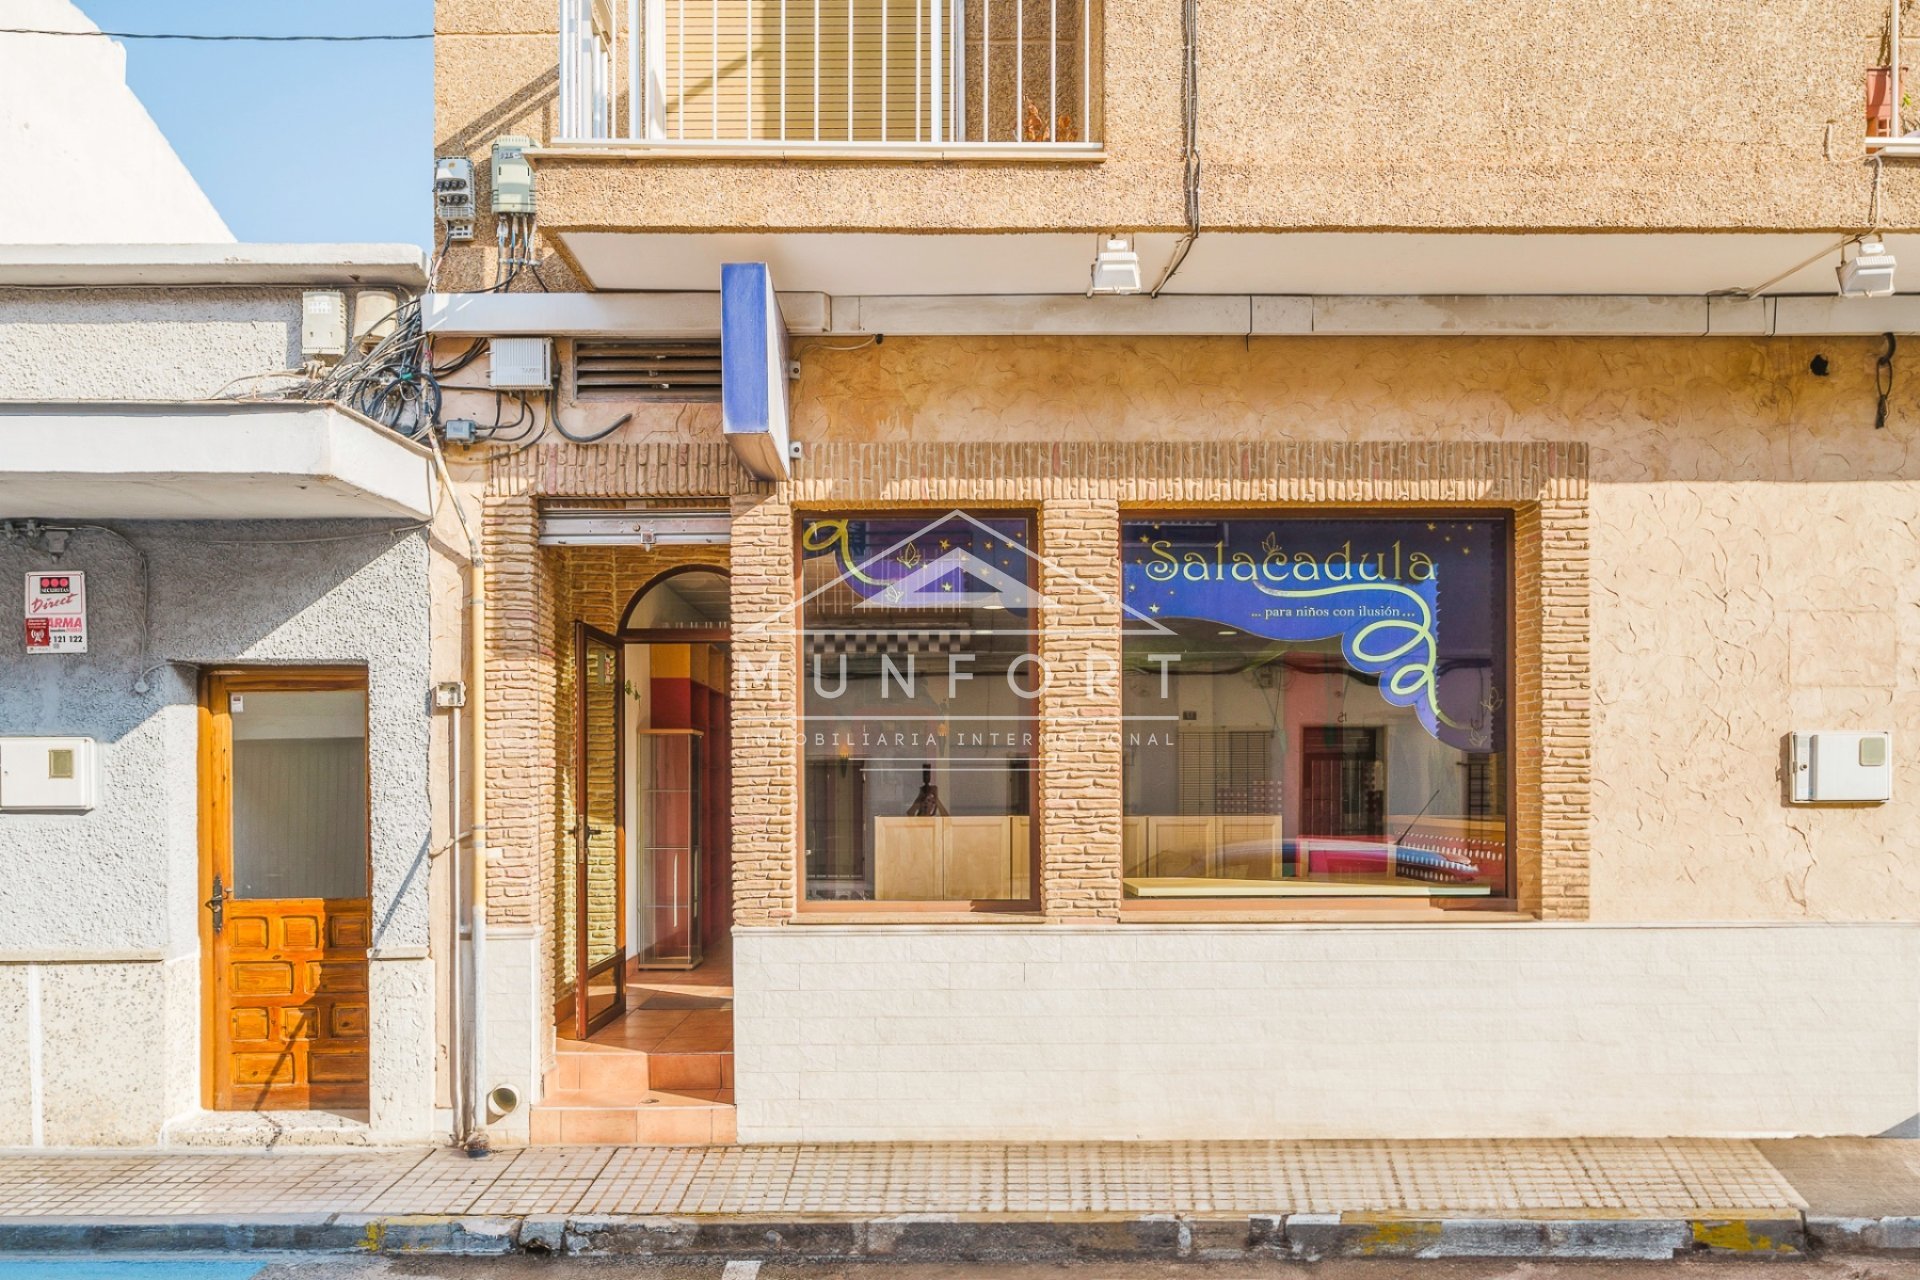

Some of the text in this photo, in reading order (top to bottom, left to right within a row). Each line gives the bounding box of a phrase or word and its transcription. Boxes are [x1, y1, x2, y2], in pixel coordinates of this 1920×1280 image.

[1145, 540, 1437, 581] Salacadula
[32, 593, 78, 612] Direct
[1265, 608, 1293, 620] para
[1296, 606, 1329, 617] niños
[1333, 608, 1355, 617] con
[53, 635, 66, 643] 121
[69, 635, 83, 643] 122
